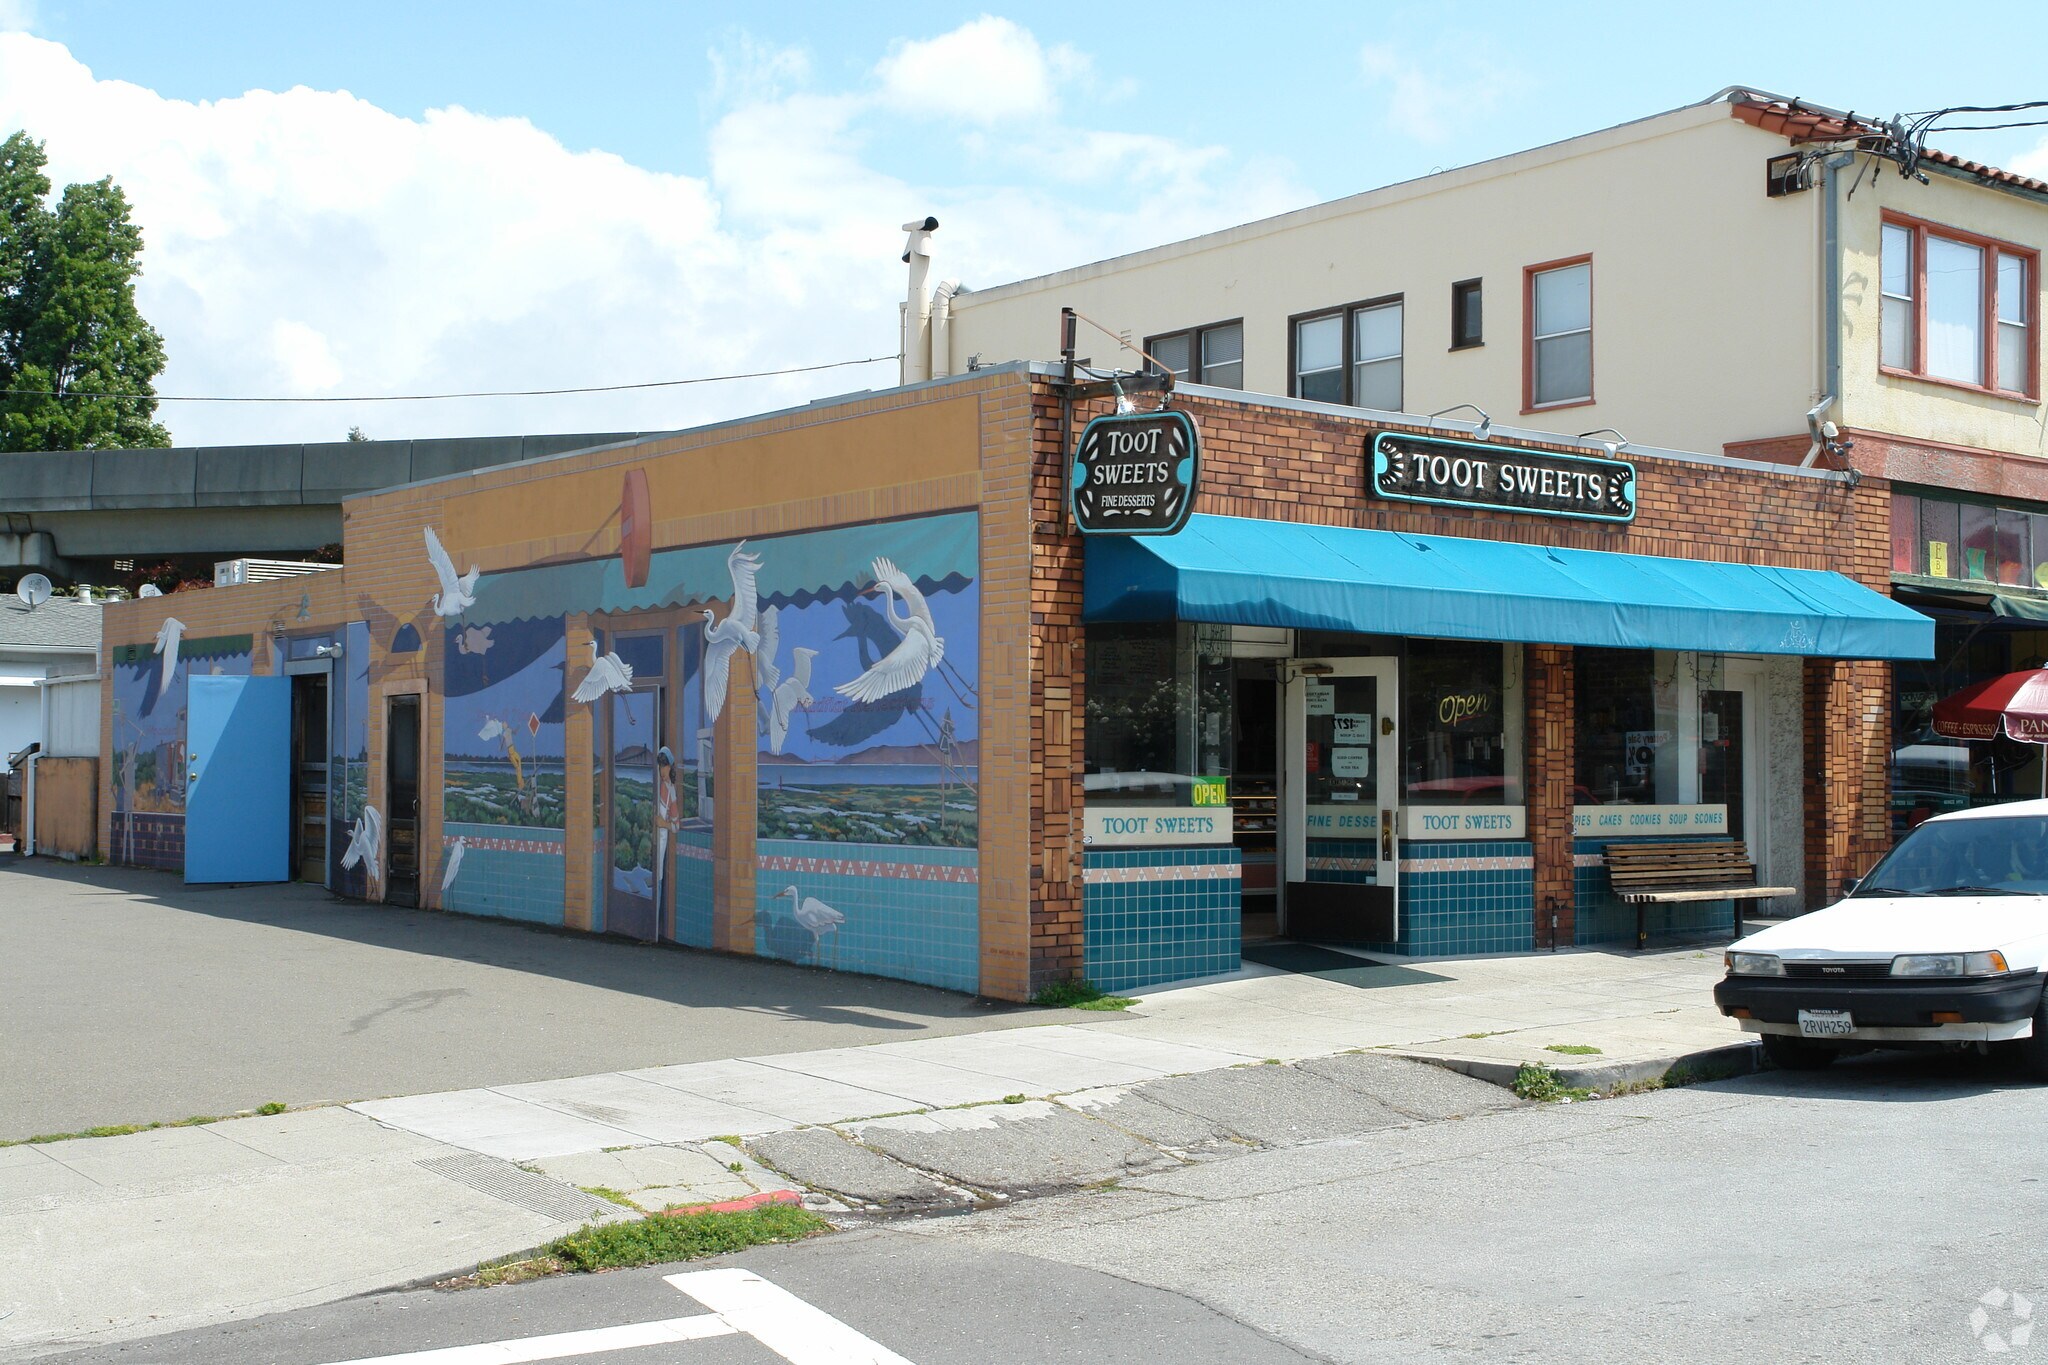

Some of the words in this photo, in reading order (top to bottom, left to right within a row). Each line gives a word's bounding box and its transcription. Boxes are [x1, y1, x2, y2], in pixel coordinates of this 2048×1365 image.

[1107, 428, 1162, 457] TOOT
[1093, 461, 1169, 485] SWEETS
[1412, 453, 1488, 489] TOOT
[1499, 463, 1602, 501] SWEETS
[1101, 495, 1118, 507] FINE
[1118, 494, 1156, 507] DESSERTS
[1439, 693, 1490, 727] Open
[1936, 720, 1959, 734] COFFEE
[1962, 722, 1996, 736] ESPRESSO
[1194, 784, 1225, 805] OPEN
[1102, 817, 1149, 834] TOOT
[1155, 817, 1214, 834] SWEETS
[1307, 815, 1332, 827] FINE
[1338, 815, 1377, 828] DESSE
[1423, 815, 1460, 830] TOOT
[1465, 814, 1512, 830] SWEETS
[1574, 814, 1592, 826] PIES
[1598, 814, 1622, 826] CAKES
[1630, 813, 1662, 826] COOKIES
[1669, 813, 1688, 825] SOUP
[1694, 812, 1723, 825] SCONES
[1803, 1020, 1852, 1034] 2RVH259
